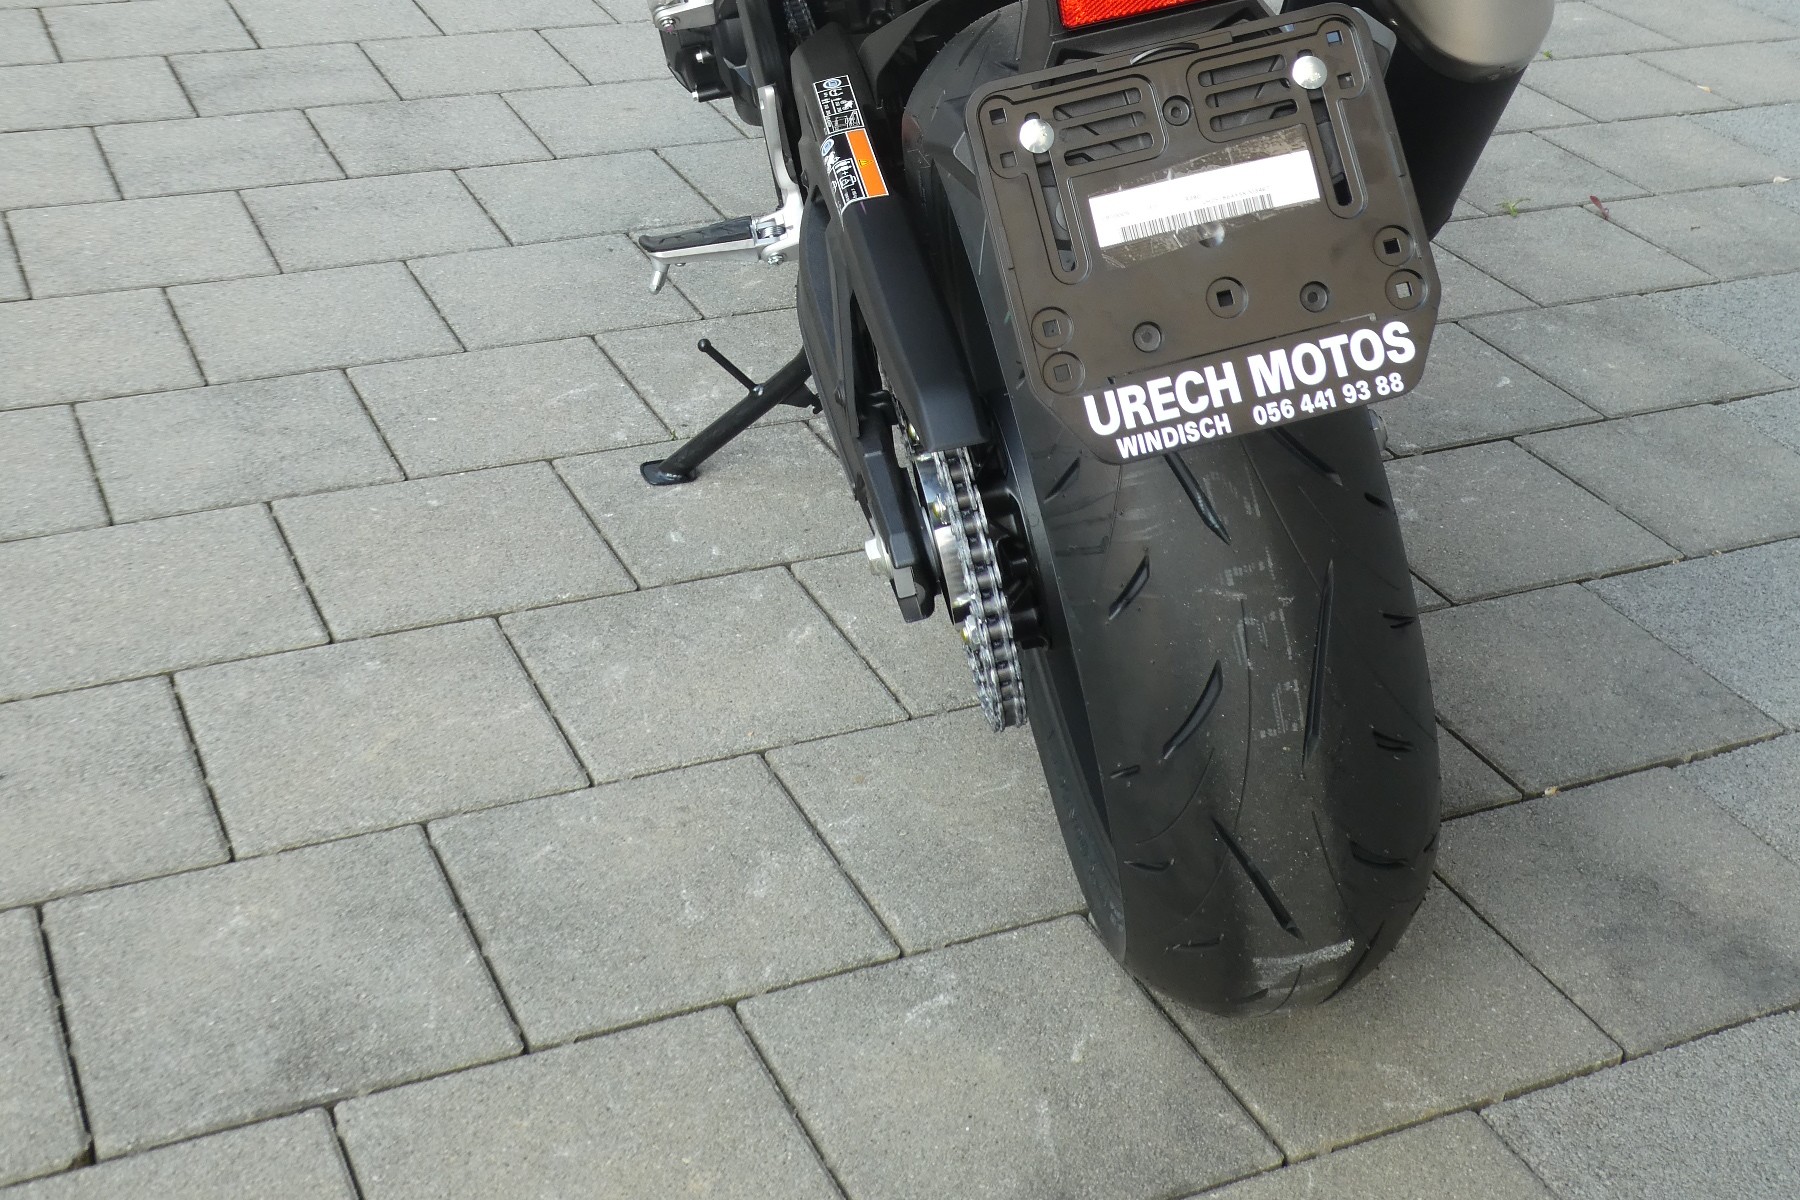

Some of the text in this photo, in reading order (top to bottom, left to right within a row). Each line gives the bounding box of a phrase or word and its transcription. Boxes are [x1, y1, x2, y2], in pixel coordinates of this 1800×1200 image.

[1083, 320, 1416, 436] URECH MOTOS
[1115, 372, 1405, 460] WINDISCH 056 441 93 88
